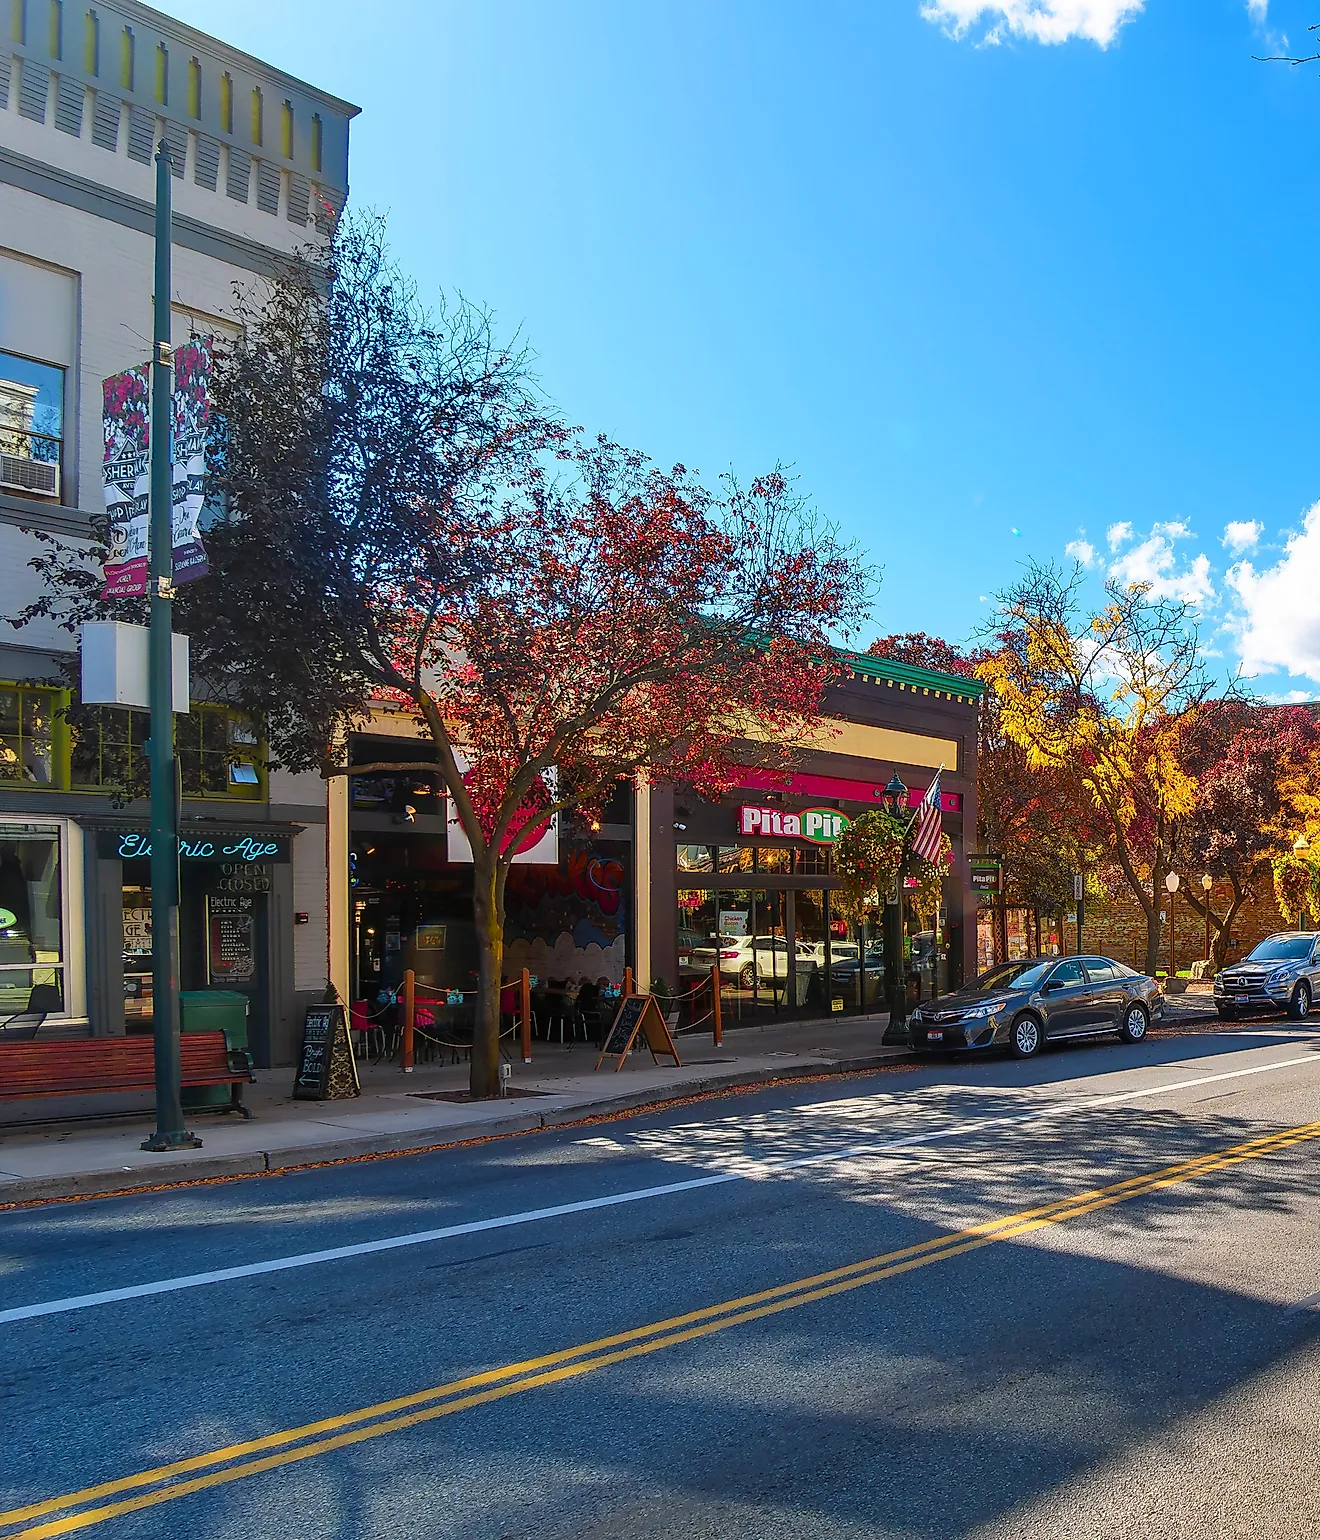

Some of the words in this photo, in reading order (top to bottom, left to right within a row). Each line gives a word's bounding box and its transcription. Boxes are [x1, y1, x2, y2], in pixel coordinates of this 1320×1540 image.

[743, 807, 800, 835] Pita
[806, 812, 842, 837] Pit
[118, 834, 215, 858] Eleric
[222, 837, 279, 861] Age
[972, 875, 986, 883] Pita
